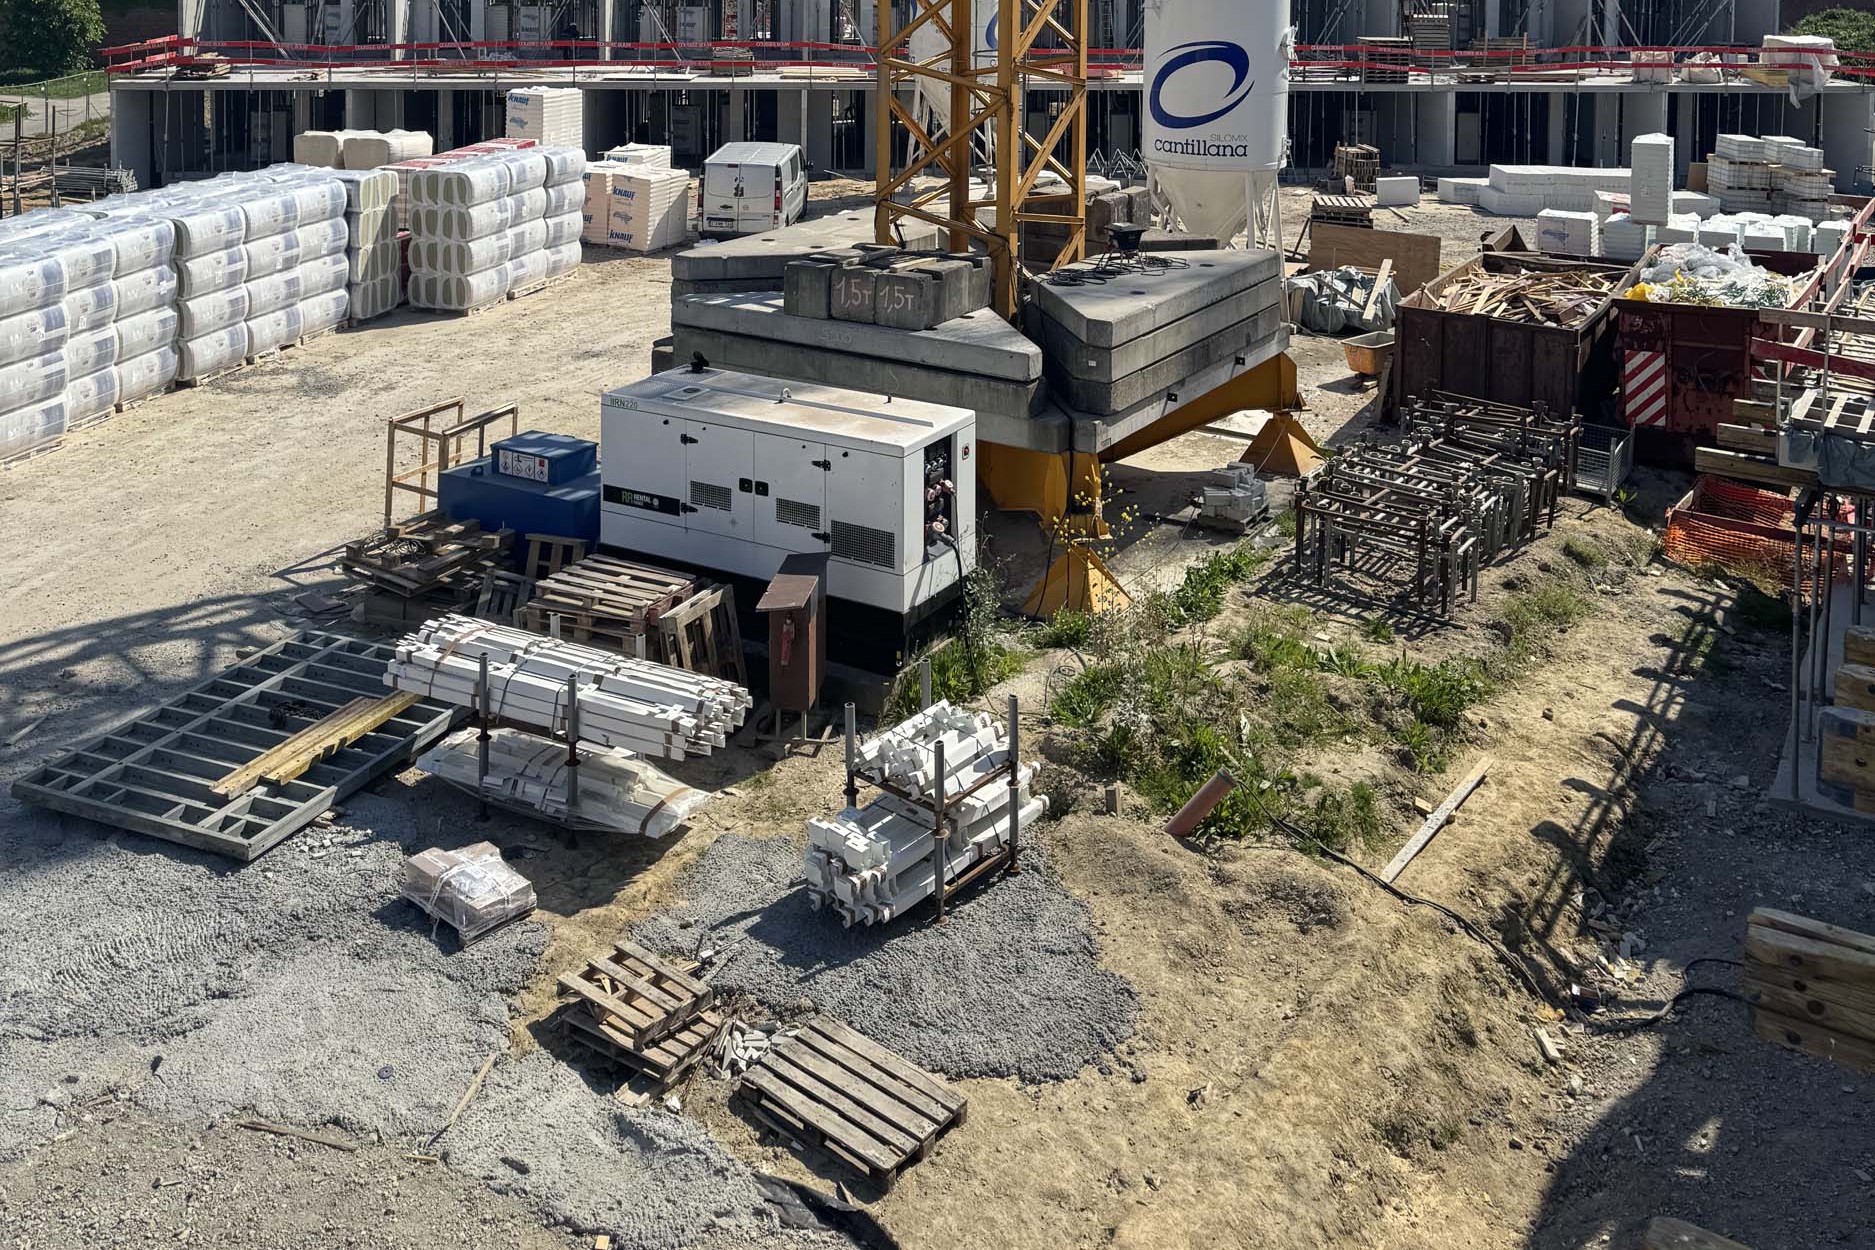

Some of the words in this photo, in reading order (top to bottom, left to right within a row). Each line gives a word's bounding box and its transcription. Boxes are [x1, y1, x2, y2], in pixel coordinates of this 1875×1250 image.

[508, 93, 529, 105] KNAUF
[1210, 134, 1248, 142] SILOMIX
[1154, 139, 1248, 157] cantillana
[613, 185, 636, 200] KNAUF
[609, 230, 633, 243] KNAUF
